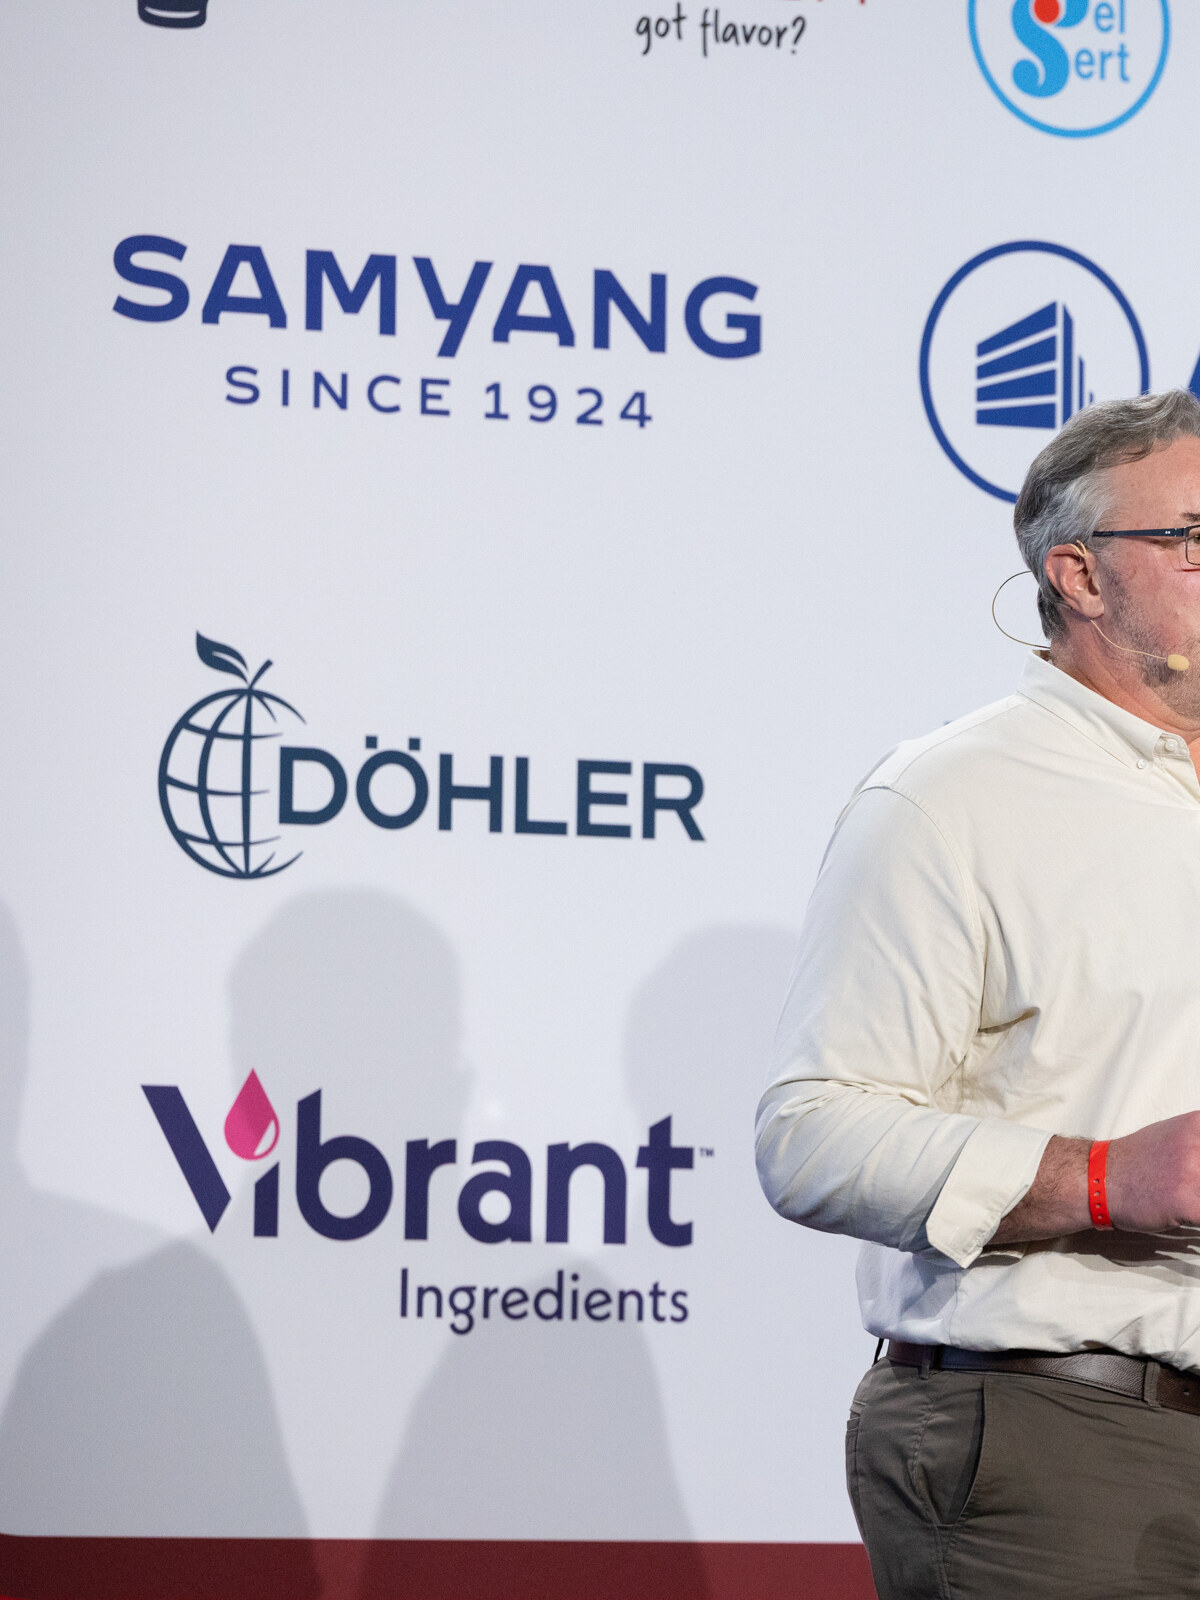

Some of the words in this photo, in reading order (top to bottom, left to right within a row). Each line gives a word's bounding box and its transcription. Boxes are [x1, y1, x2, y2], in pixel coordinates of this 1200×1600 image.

[636, 2, 686, 55] got
[700, 8, 807, 58] flavor?
[225, 366, 451, 416] SINCE
[485, 382, 653, 429] 1924
[278, 734, 706, 841] DÖHLER
[141, 1069, 694, 1247] Vibrant
[400, 1267, 689, 1335] Ingredients
